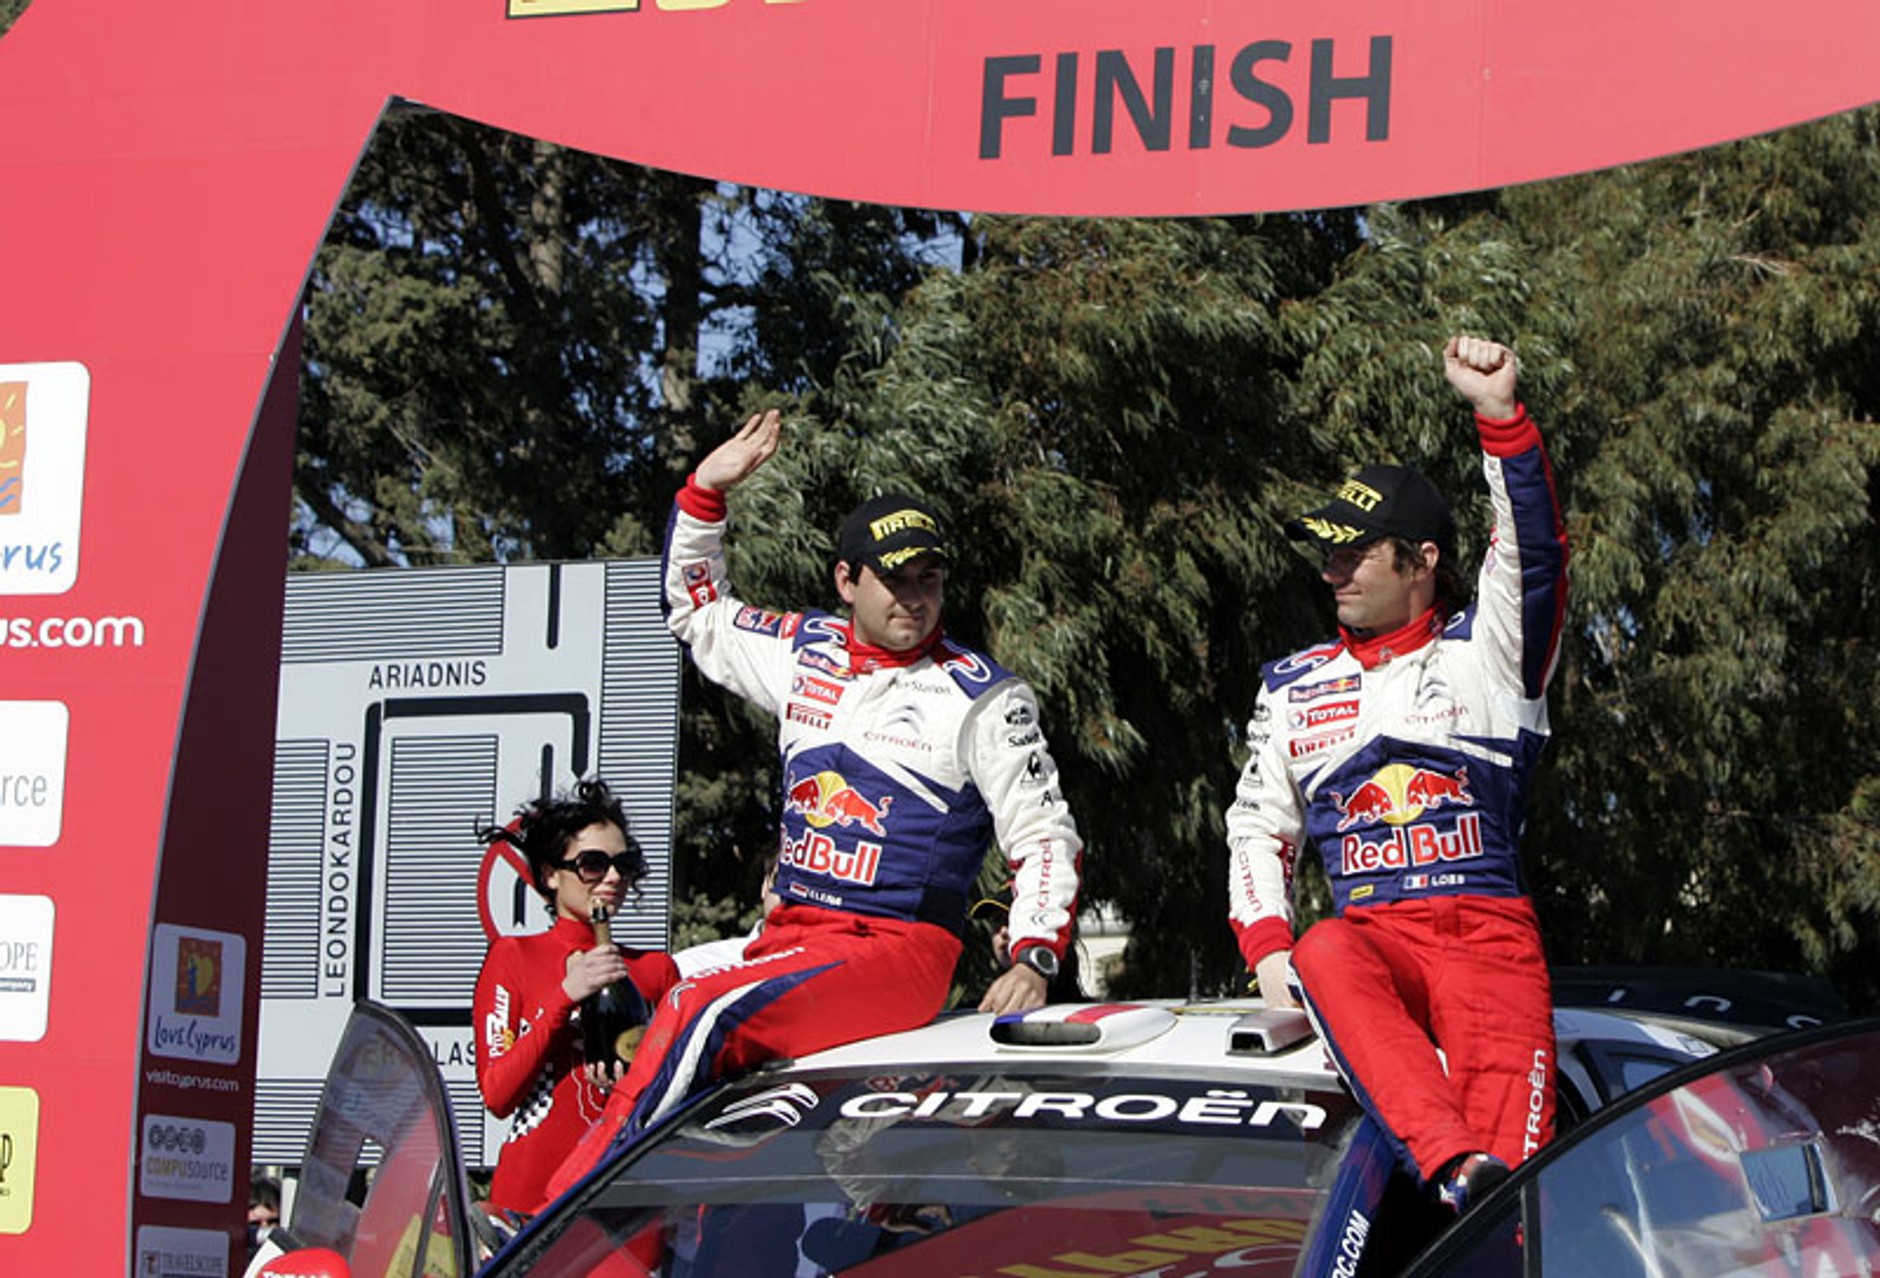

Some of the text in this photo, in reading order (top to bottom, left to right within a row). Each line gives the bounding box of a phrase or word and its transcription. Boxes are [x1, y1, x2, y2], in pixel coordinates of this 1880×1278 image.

[979, 35, 1394, 160] FINISH
[368, 660, 486, 689] ARIADNIS
[1309, 704, 1357, 724] TOTAL
[325, 743, 357, 998] LEONDOKARDOU
[807, 832, 882, 887] Bull
[1342, 826, 1407, 875] Red
[1408, 812, 1483, 867] Bull
